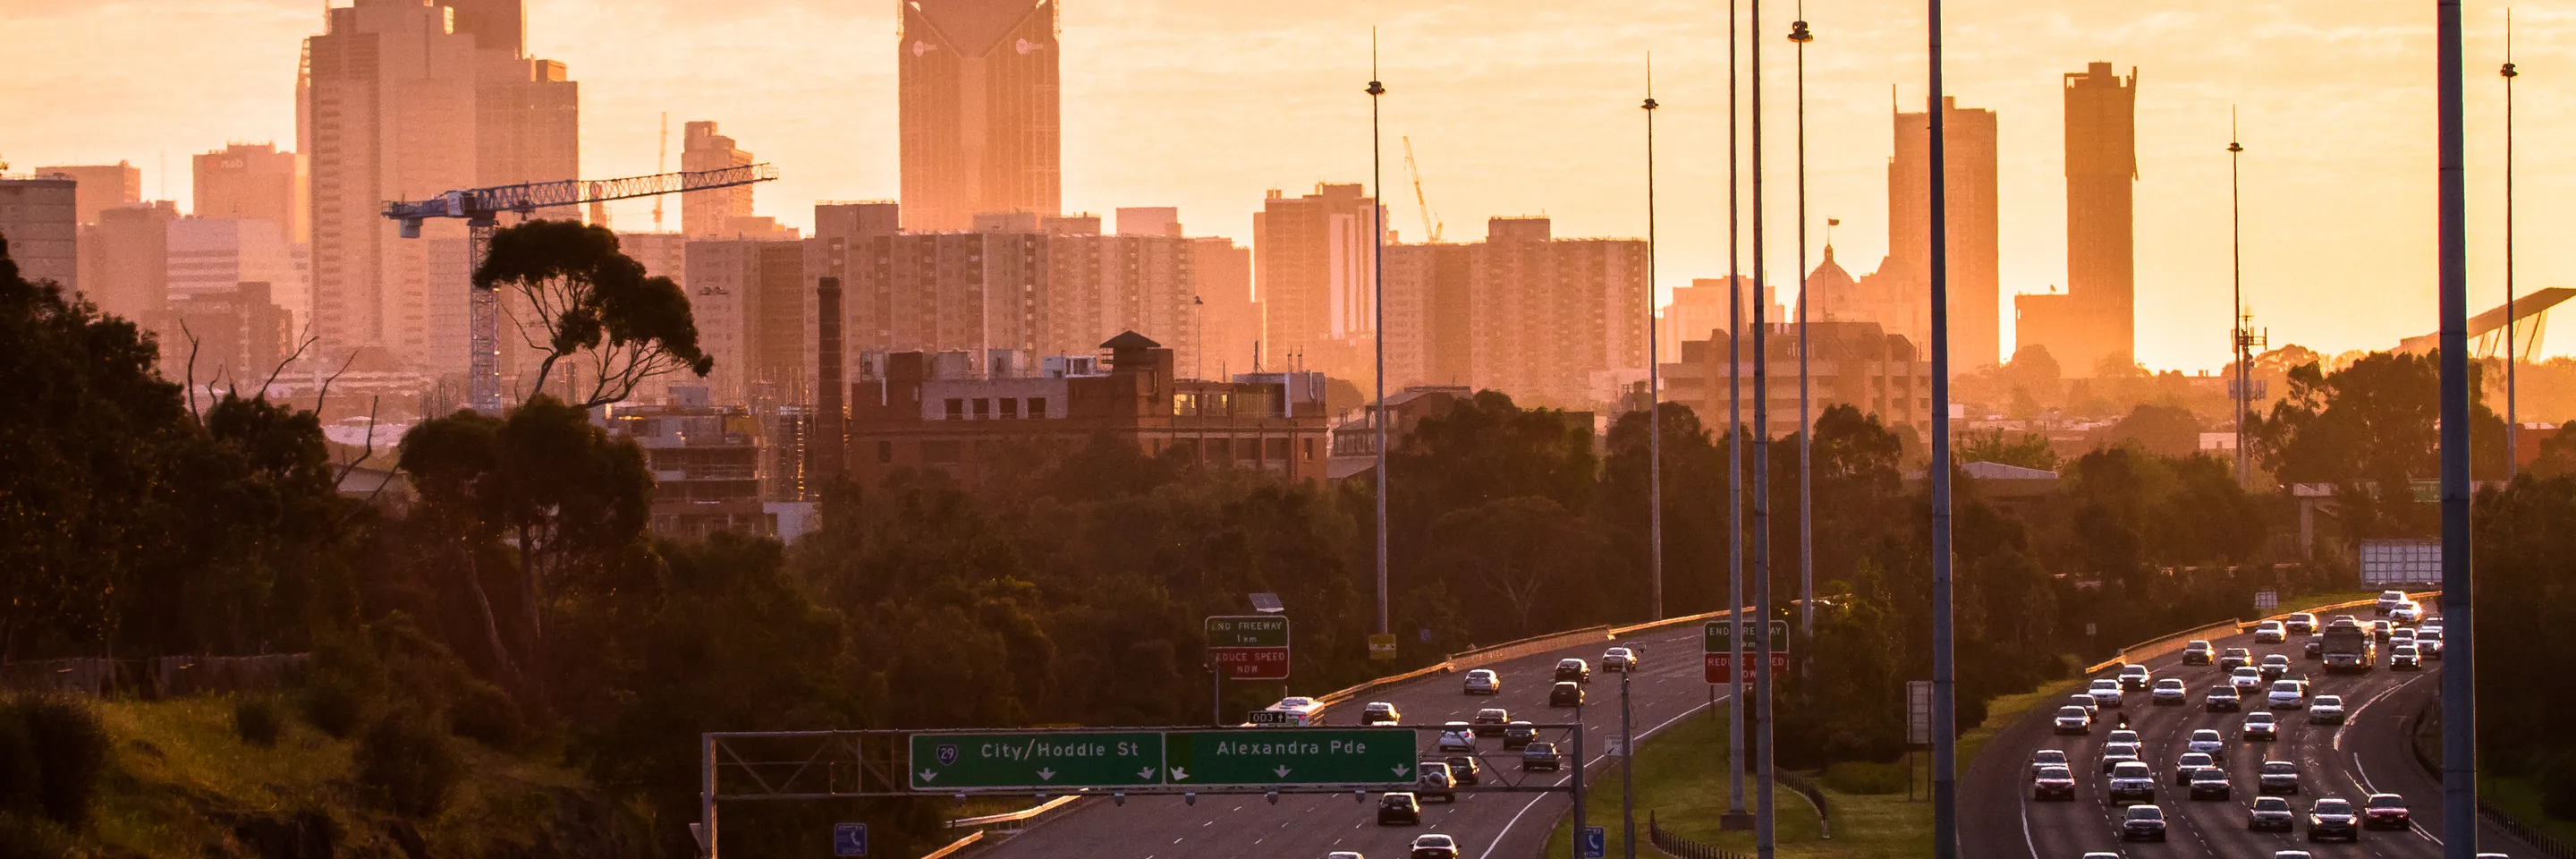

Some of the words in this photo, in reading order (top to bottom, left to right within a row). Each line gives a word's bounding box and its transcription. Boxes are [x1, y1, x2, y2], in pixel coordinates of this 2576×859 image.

[1238, 621, 1283, 631] FREEWAY
[1709, 627, 1730, 636] END
[1742, 626, 1782, 635] REAY
[1216, 652, 1248, 662] EDUCE
[1254, 651, 1285, 662] SPEED
[1707, 658, 1747, 667] REDUE
[1236, 665, 1258, 674] NOW
[1742, 670, 1757, 678] OW
[980, 738, 1106, 761] City/Hoddle
[1116, 741, 1139, 757] St
[1216, 740, 1320, 755] Alexandra
[1330, 740, 1367, 755] Pde
[940, 747, 954, 760] 29
